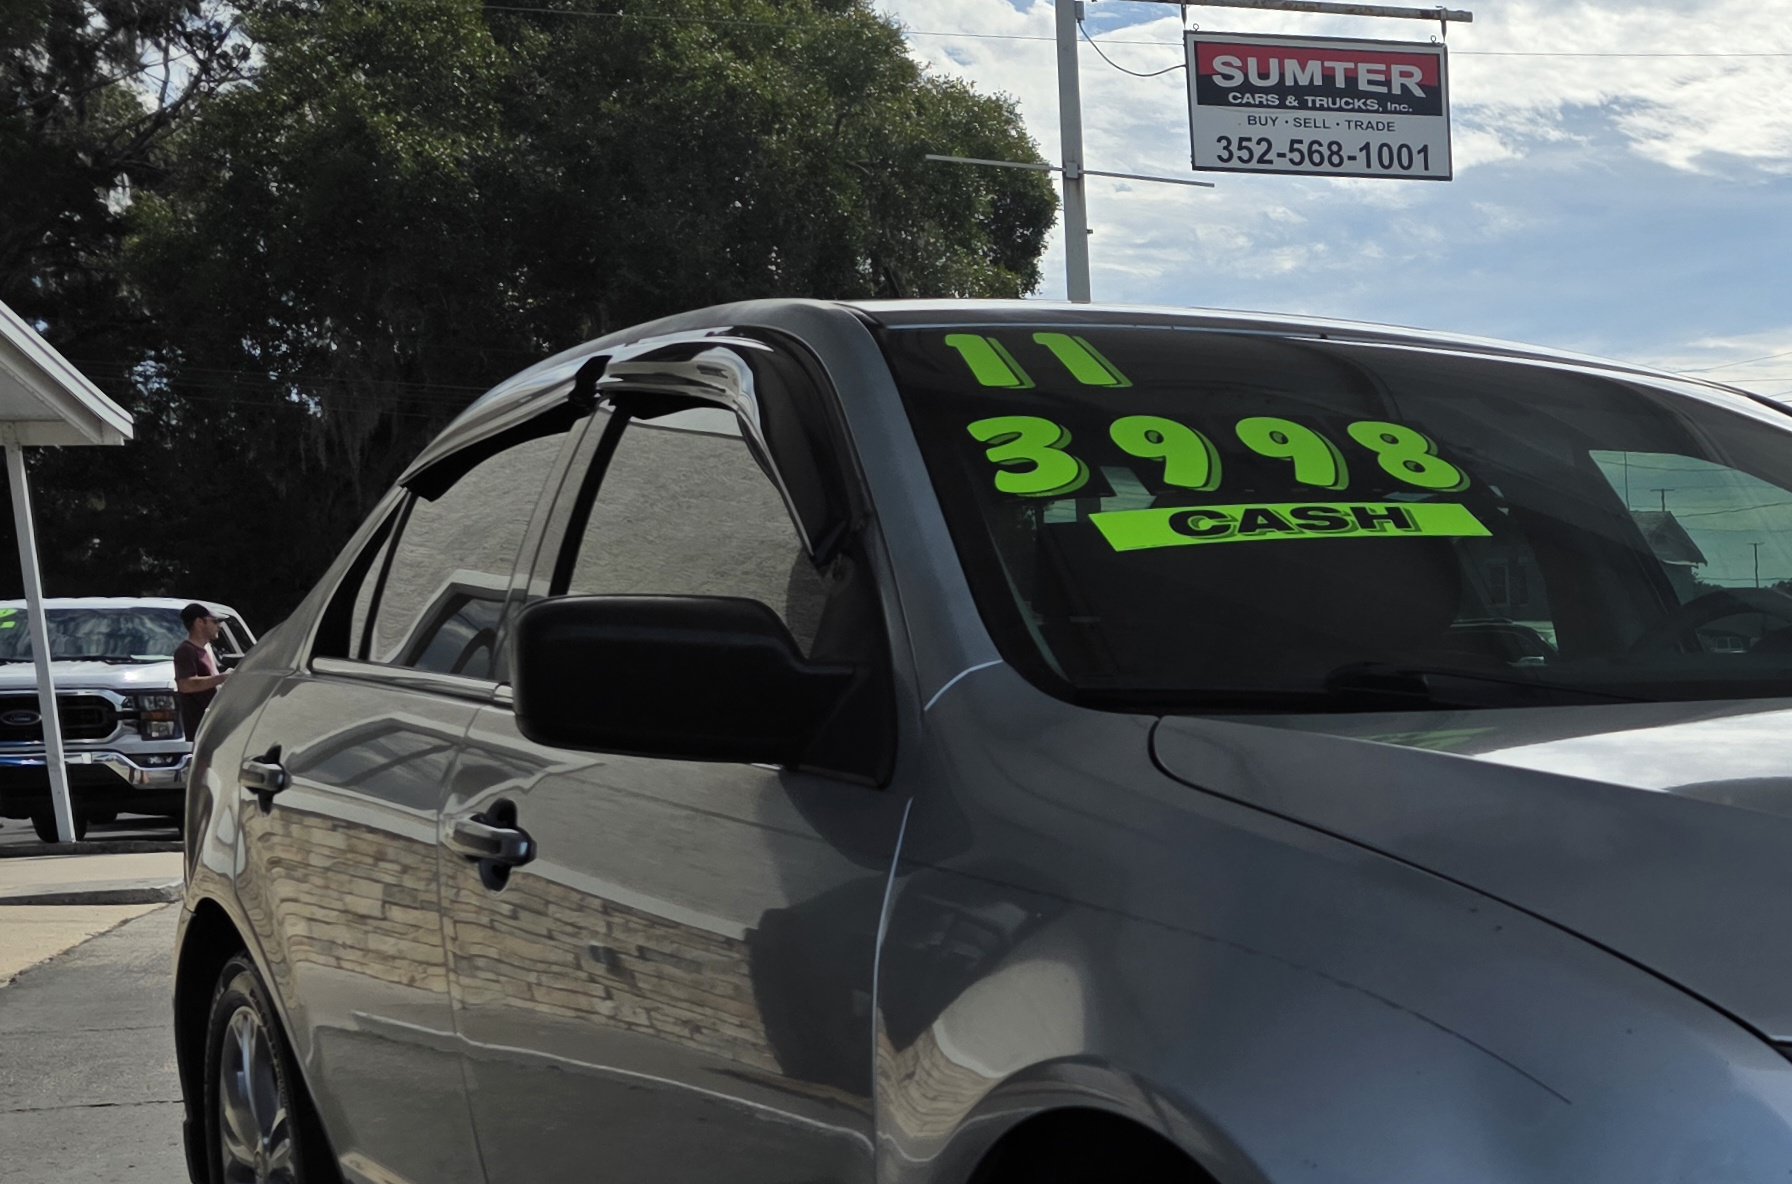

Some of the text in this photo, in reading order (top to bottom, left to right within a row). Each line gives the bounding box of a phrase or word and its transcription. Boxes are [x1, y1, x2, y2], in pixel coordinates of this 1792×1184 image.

[1211, 55, 1427, 98] SUMTER
[1227, 91, 1413, 113] CARS & TRUCKS, Inc.
[1247, 114, 1396, 132] BUY SELL TRADE
[1216, 135, 1430, 171] 352-568-1001
[945, 333, 1132, 389] 11
[967, 415, 1471, 496] 3998
[1168, 504, 1422, 540] CASH
